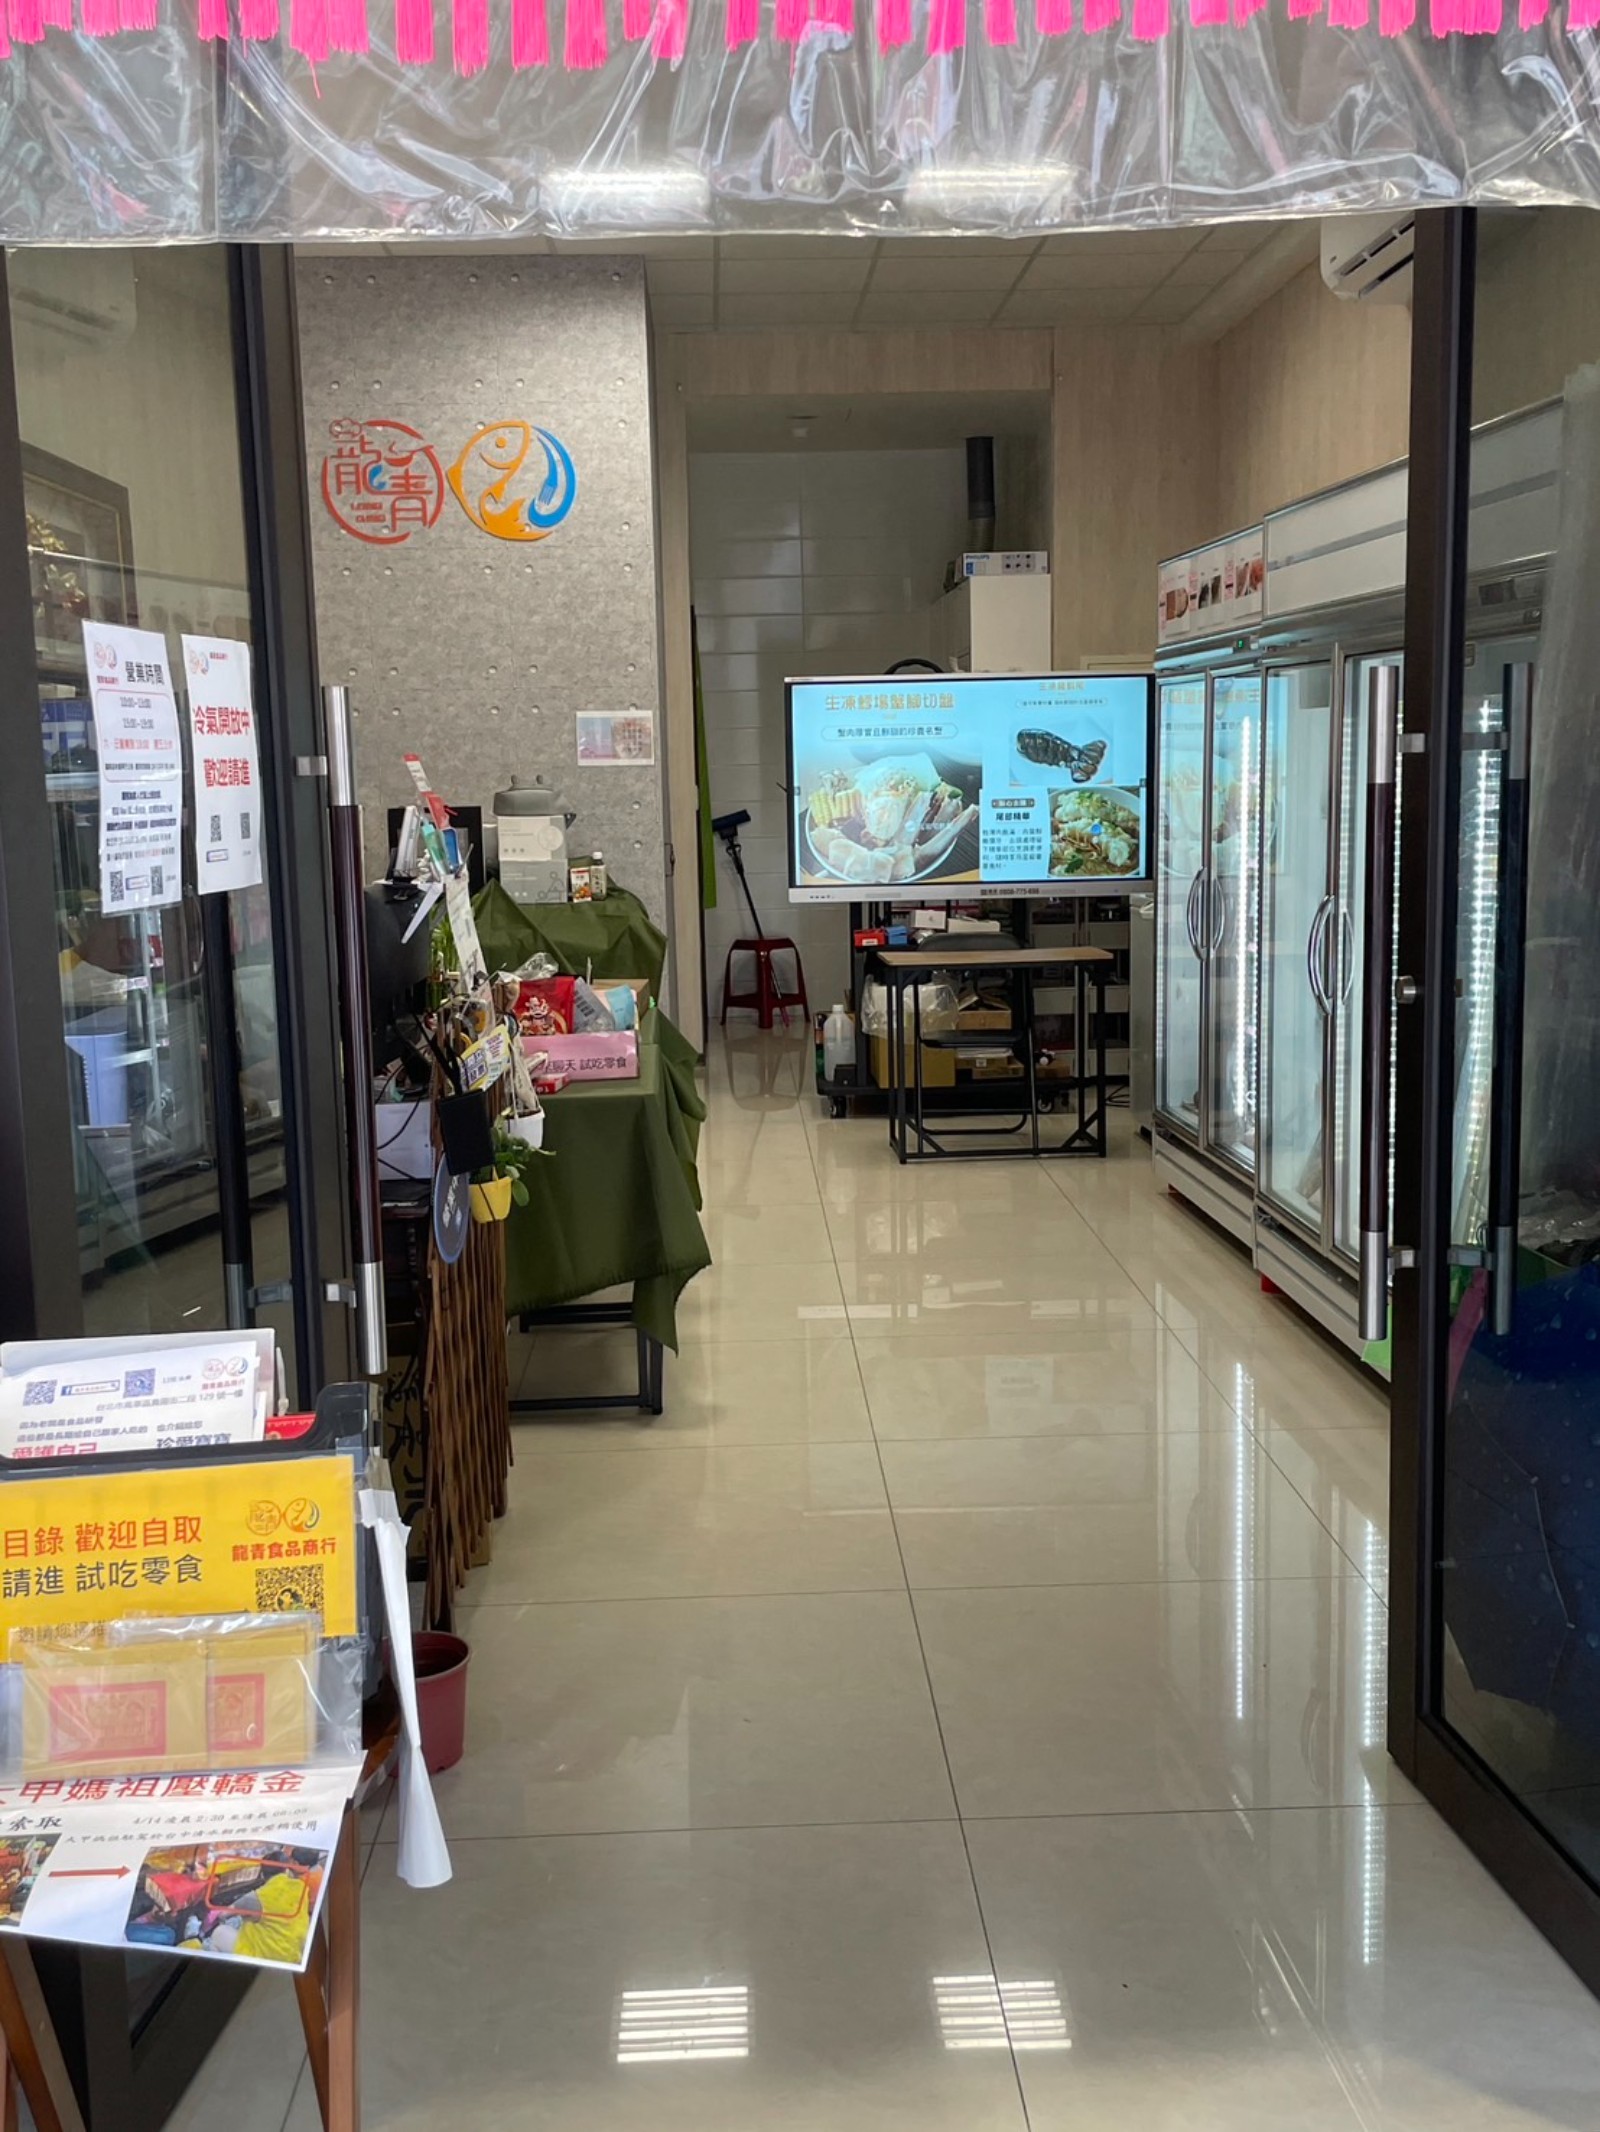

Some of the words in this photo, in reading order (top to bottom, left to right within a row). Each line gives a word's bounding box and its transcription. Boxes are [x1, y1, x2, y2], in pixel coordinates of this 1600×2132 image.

[125, 660, 166, 686] 營業時間
[192, 705, 251, 736] 冷氣開放中
[203, 758, 252, 788] 歡迎請進
[579, 1056, 628, 1071] 試吃零食
[4, 1526, 64, 1559] 目錄
[75, 1515, 203, 1553] 歡迎自取
[231, 1537, 337, 1562] 龍青食品商行
[2, 1565, 65, 1599] 請進
[75, 1553, 203, 1593] 試吃零食
[0, 1815, 63, 1831] 索取
